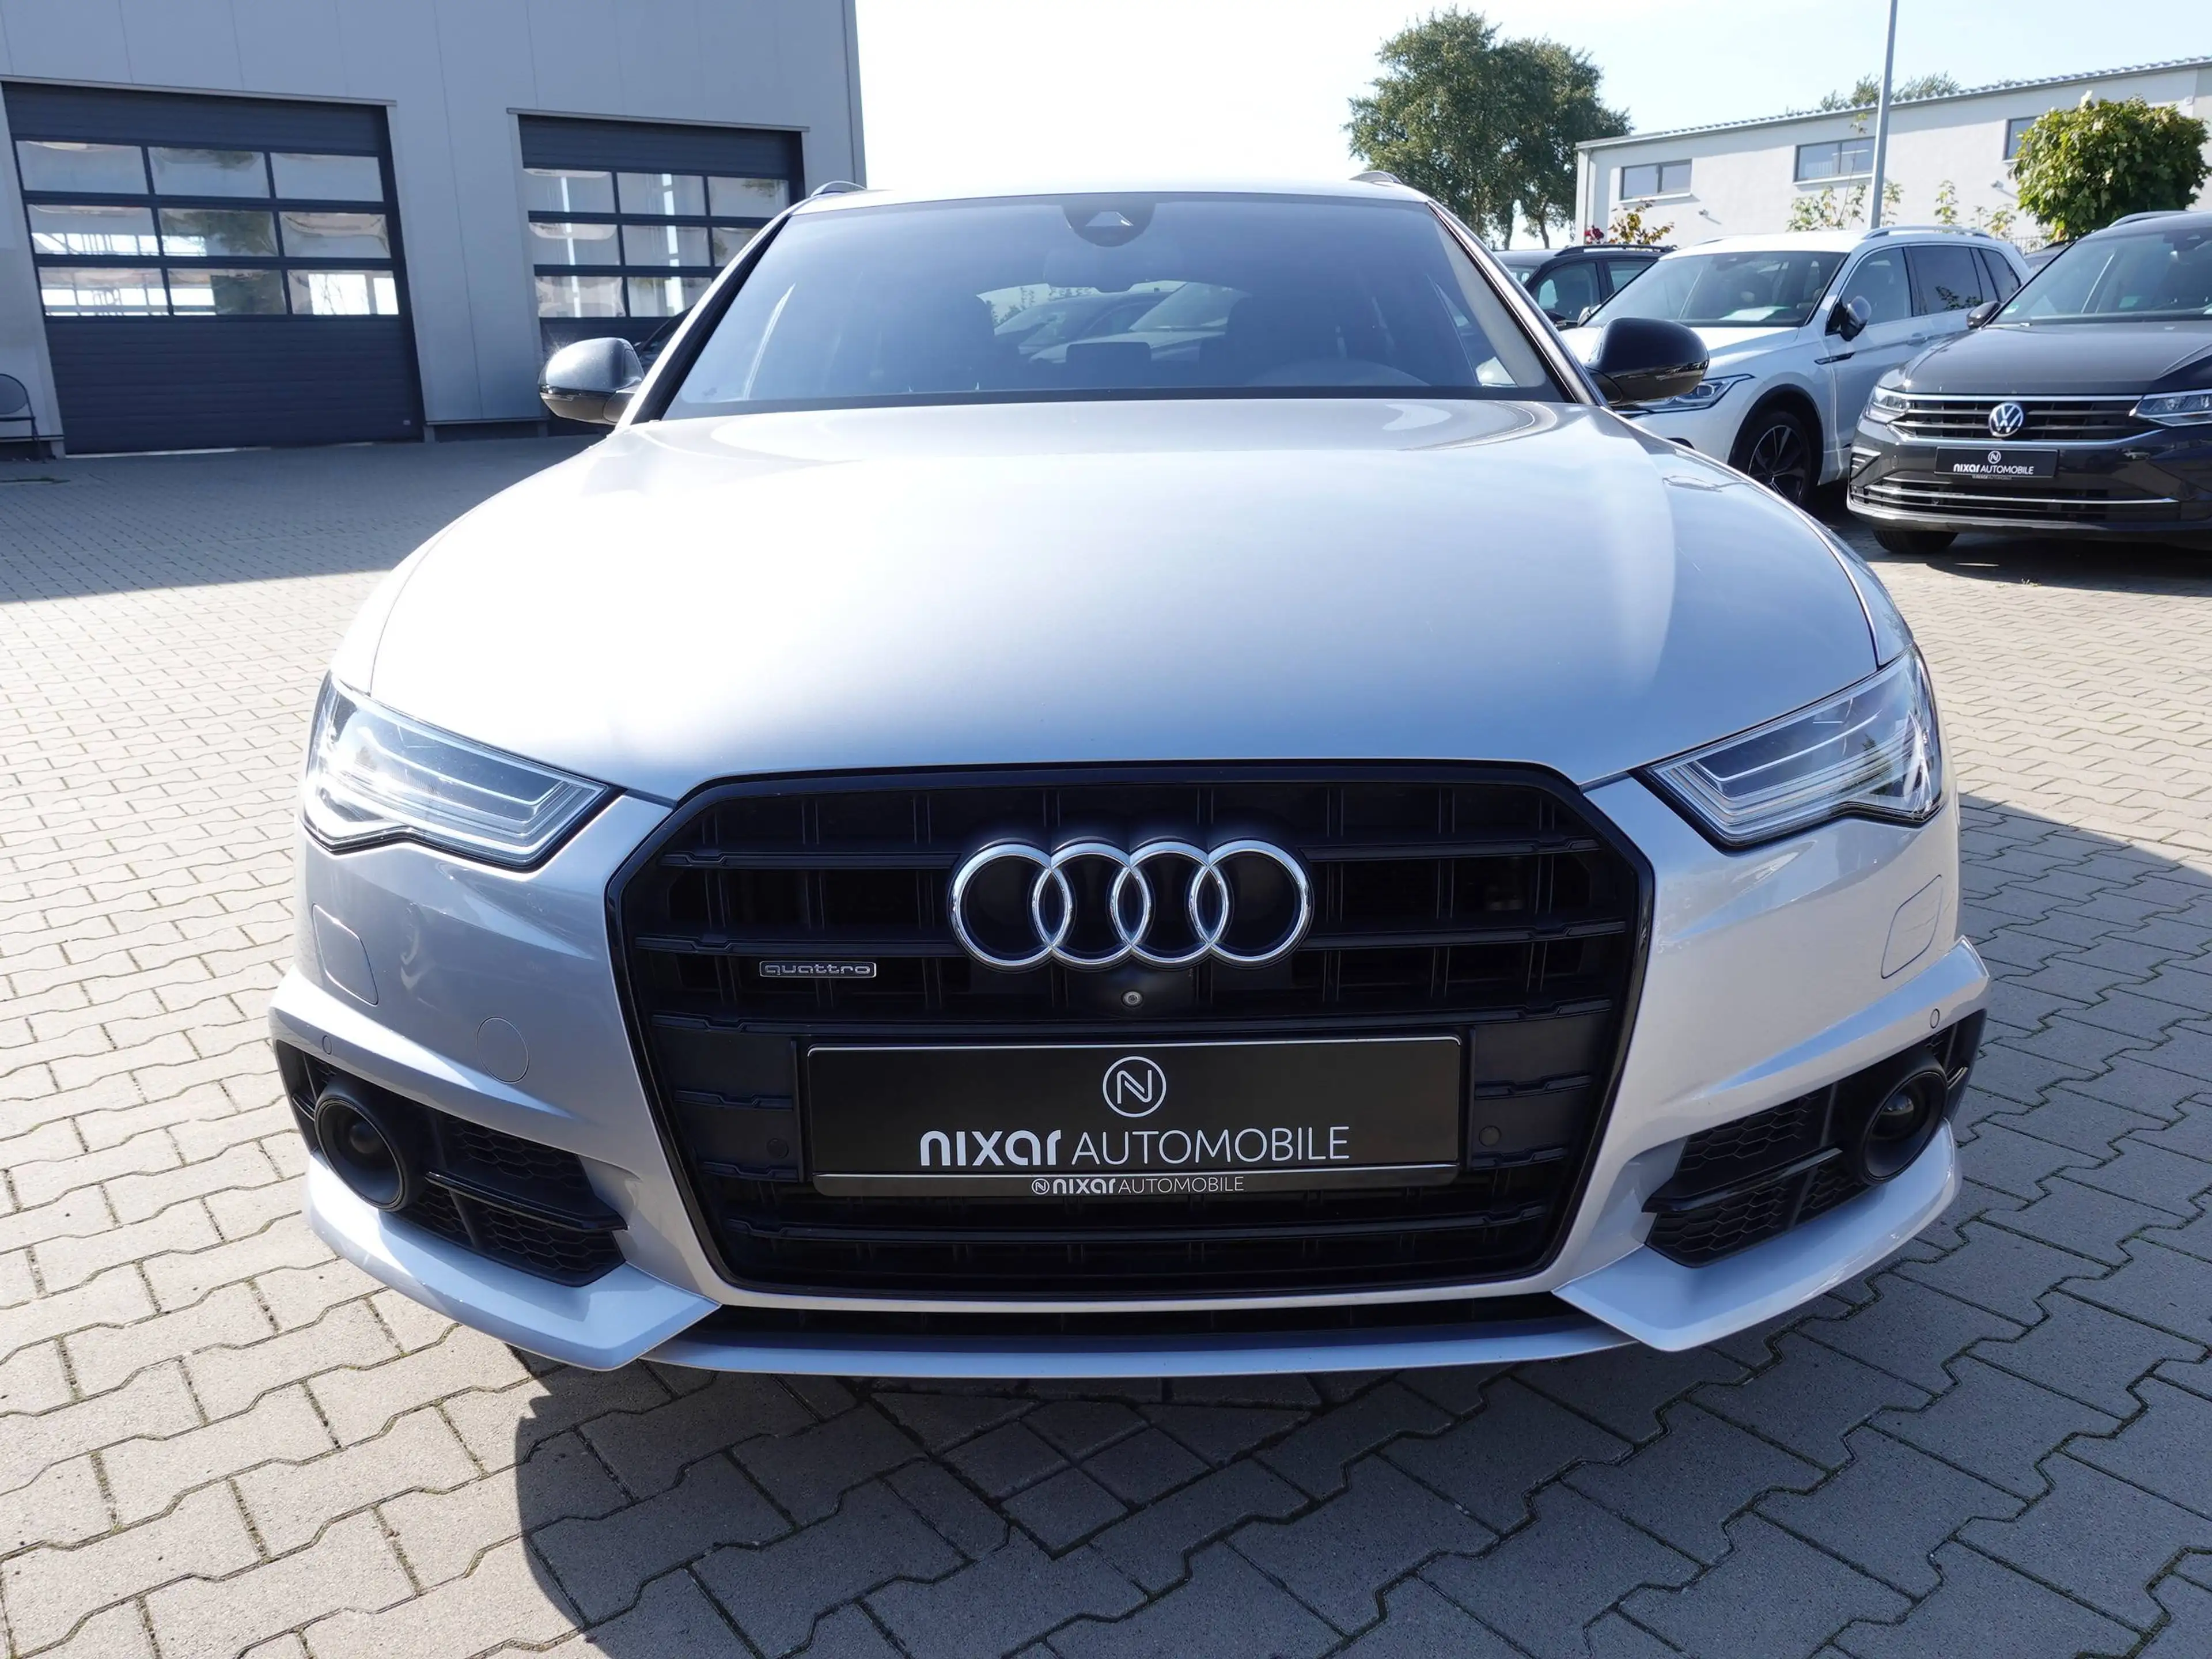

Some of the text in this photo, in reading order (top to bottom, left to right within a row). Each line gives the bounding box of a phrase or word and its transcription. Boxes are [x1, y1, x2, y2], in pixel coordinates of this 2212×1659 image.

[1953, 463, 2034, 475] nixar AUTOMOBILE
[764, 964, 870, 975] quattro
[921, 1126, 1350, 1166] nixar AUTOMOBILE
[1053, 1178, 1115, 1194] nixar
[1118, 1176, 1244, 1194] AUTOMOBILE
